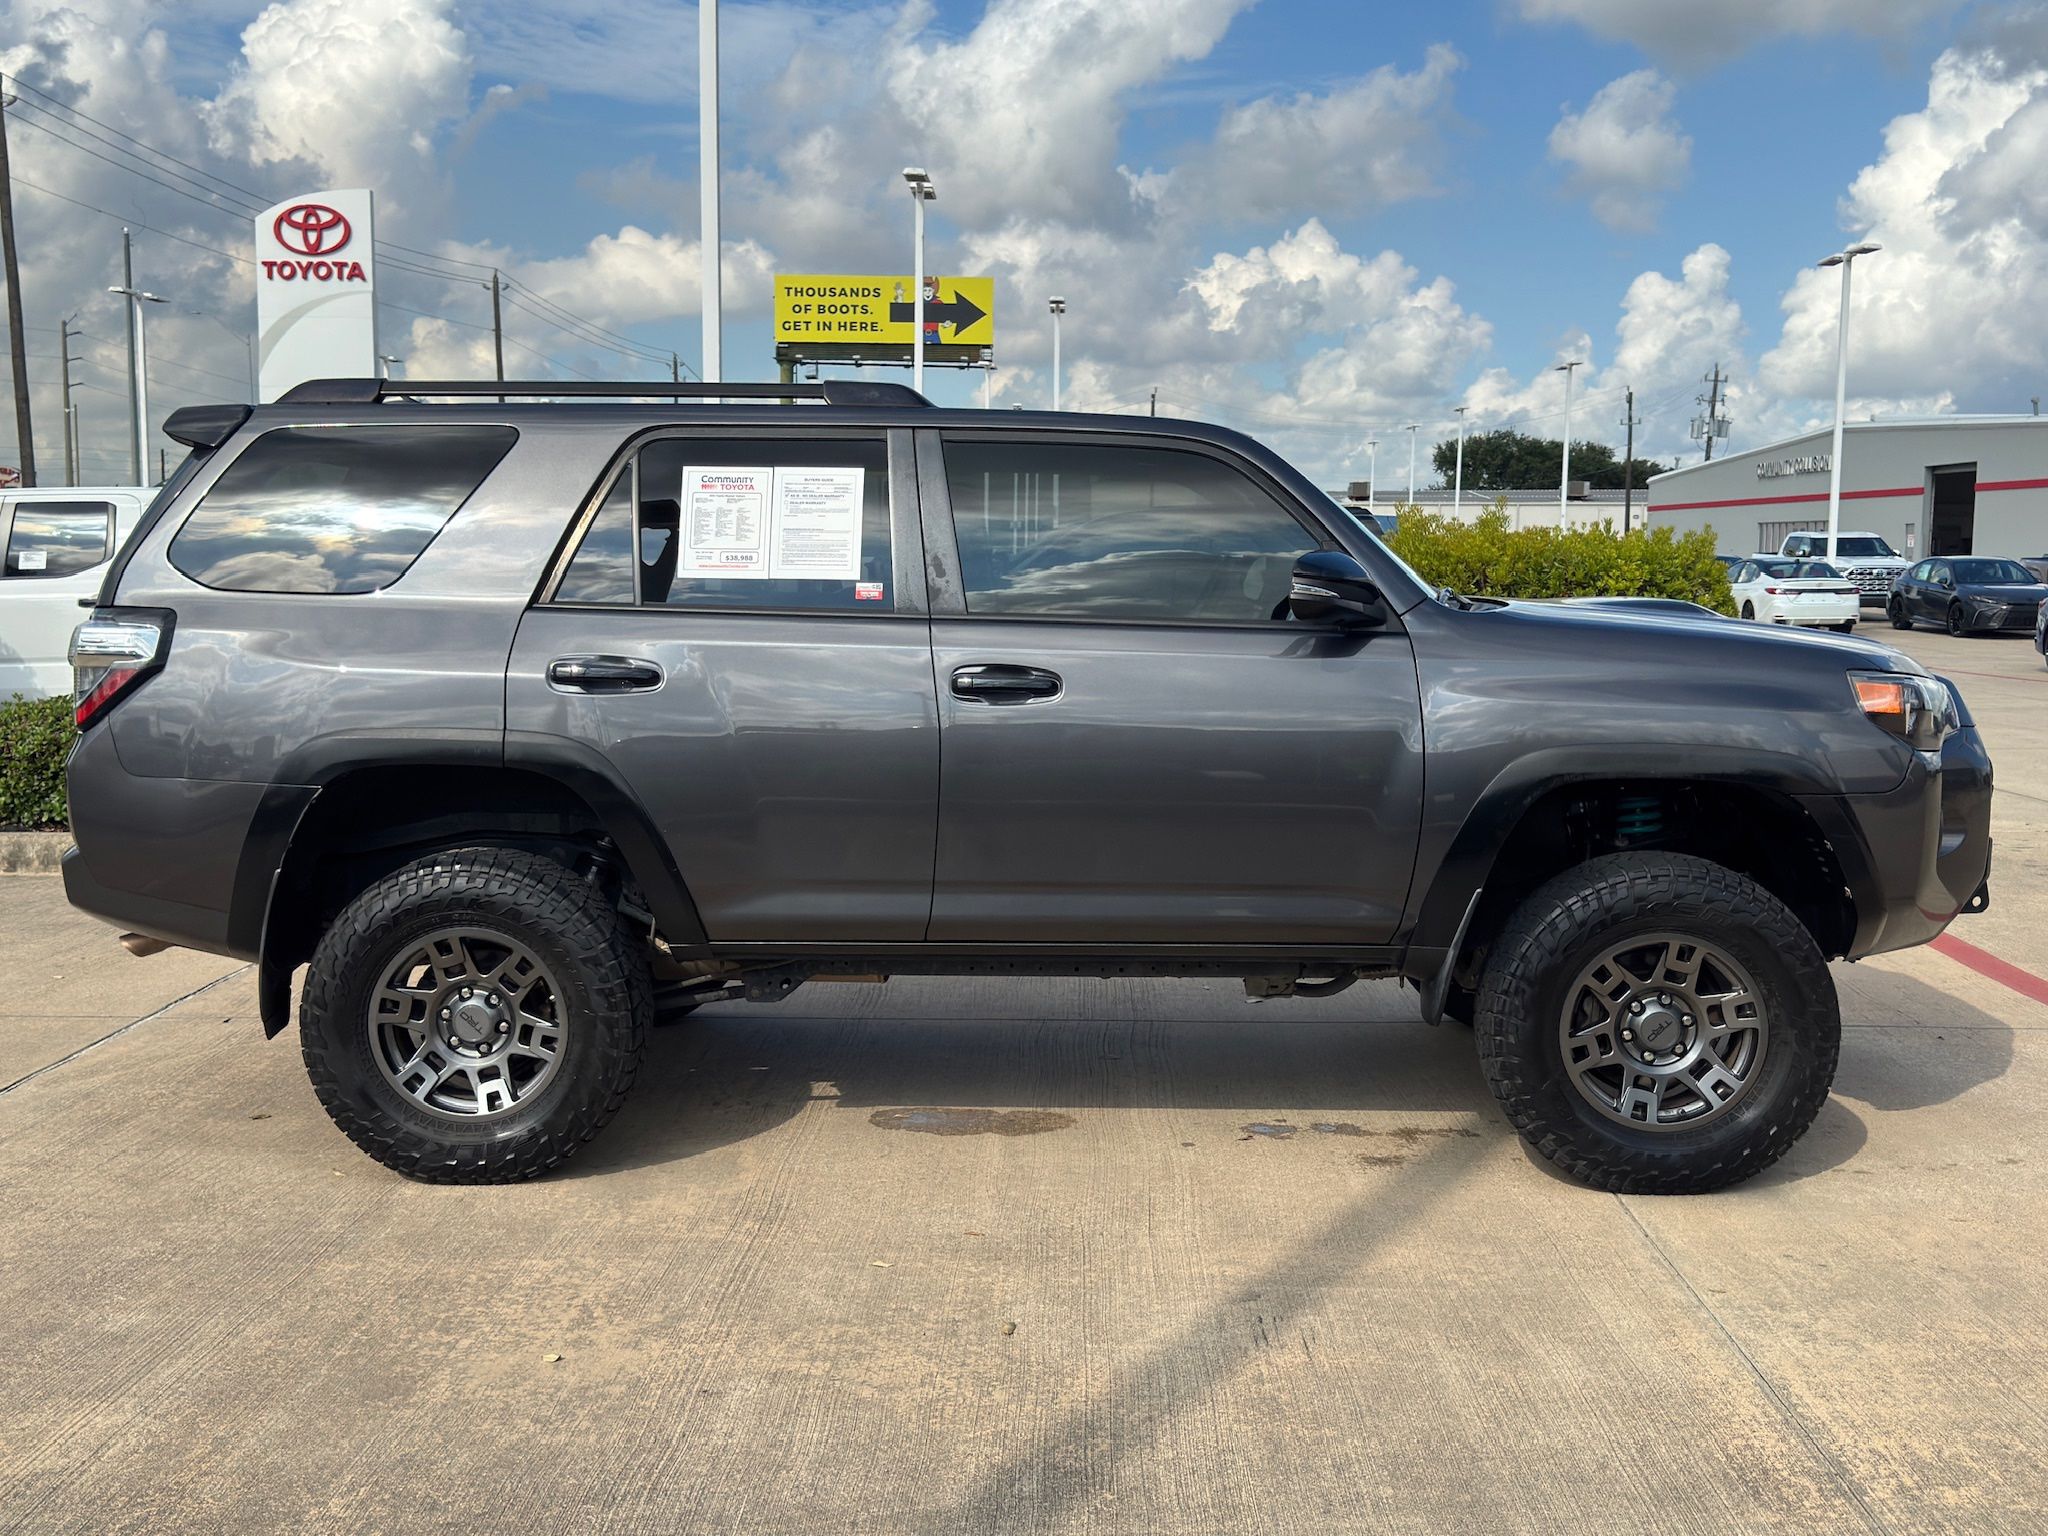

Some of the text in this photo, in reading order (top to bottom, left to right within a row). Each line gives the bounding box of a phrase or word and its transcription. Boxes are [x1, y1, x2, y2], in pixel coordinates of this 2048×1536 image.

[261, 260, 368, 283] TOYOTA
[784, 287, 881, 298] THOUSANDS
[792, 304, 873, 315] OF BOOTS.
[782, 321, 884, 332] GET IN HERE.
[1795, 454, 1832, 473] COLLISION
[720, 483, 755, 491] TOYOTA
[459, 1010, 483, 1036] TRD
[1647, 1020, 1674, 1042] TRD
